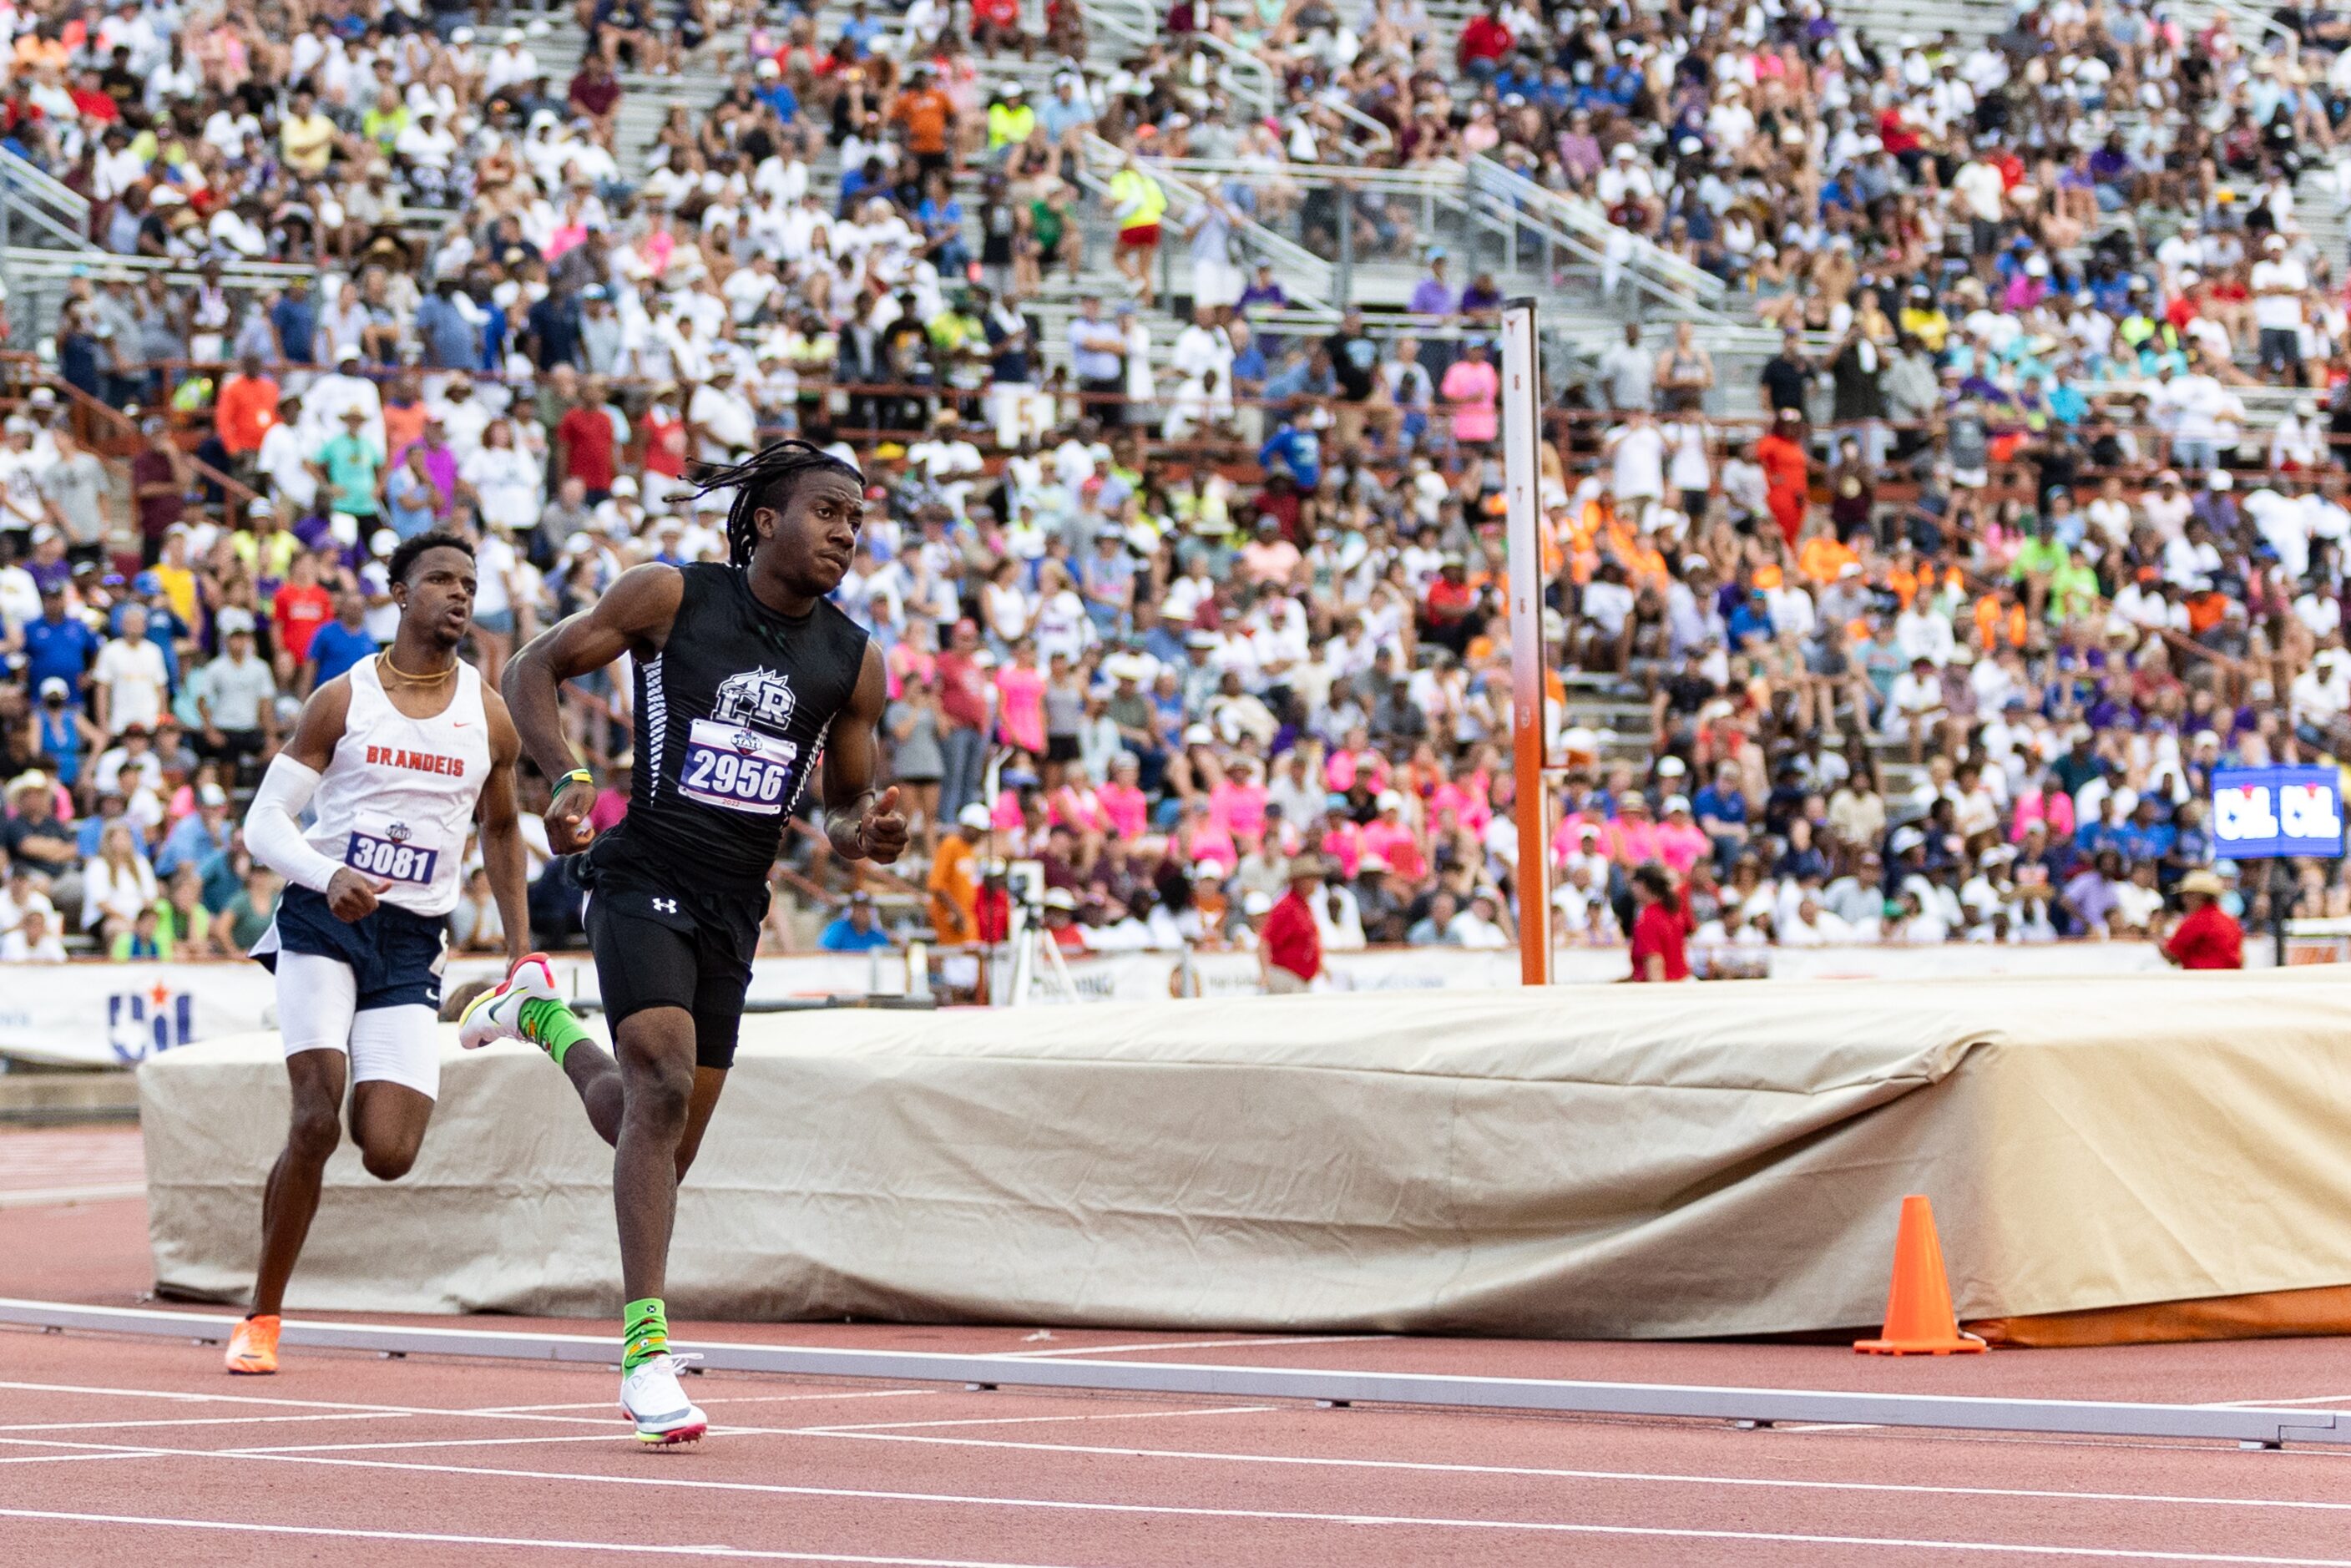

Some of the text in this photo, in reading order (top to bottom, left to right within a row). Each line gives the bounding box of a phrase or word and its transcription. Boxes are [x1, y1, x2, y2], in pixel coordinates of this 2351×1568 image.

[366, 745, 465, 777] BRANDEIS
[687, 749, 786, 801] 2956
[722, 798, 741, 807] 2022
[352, 837, 430, 882] 3081
